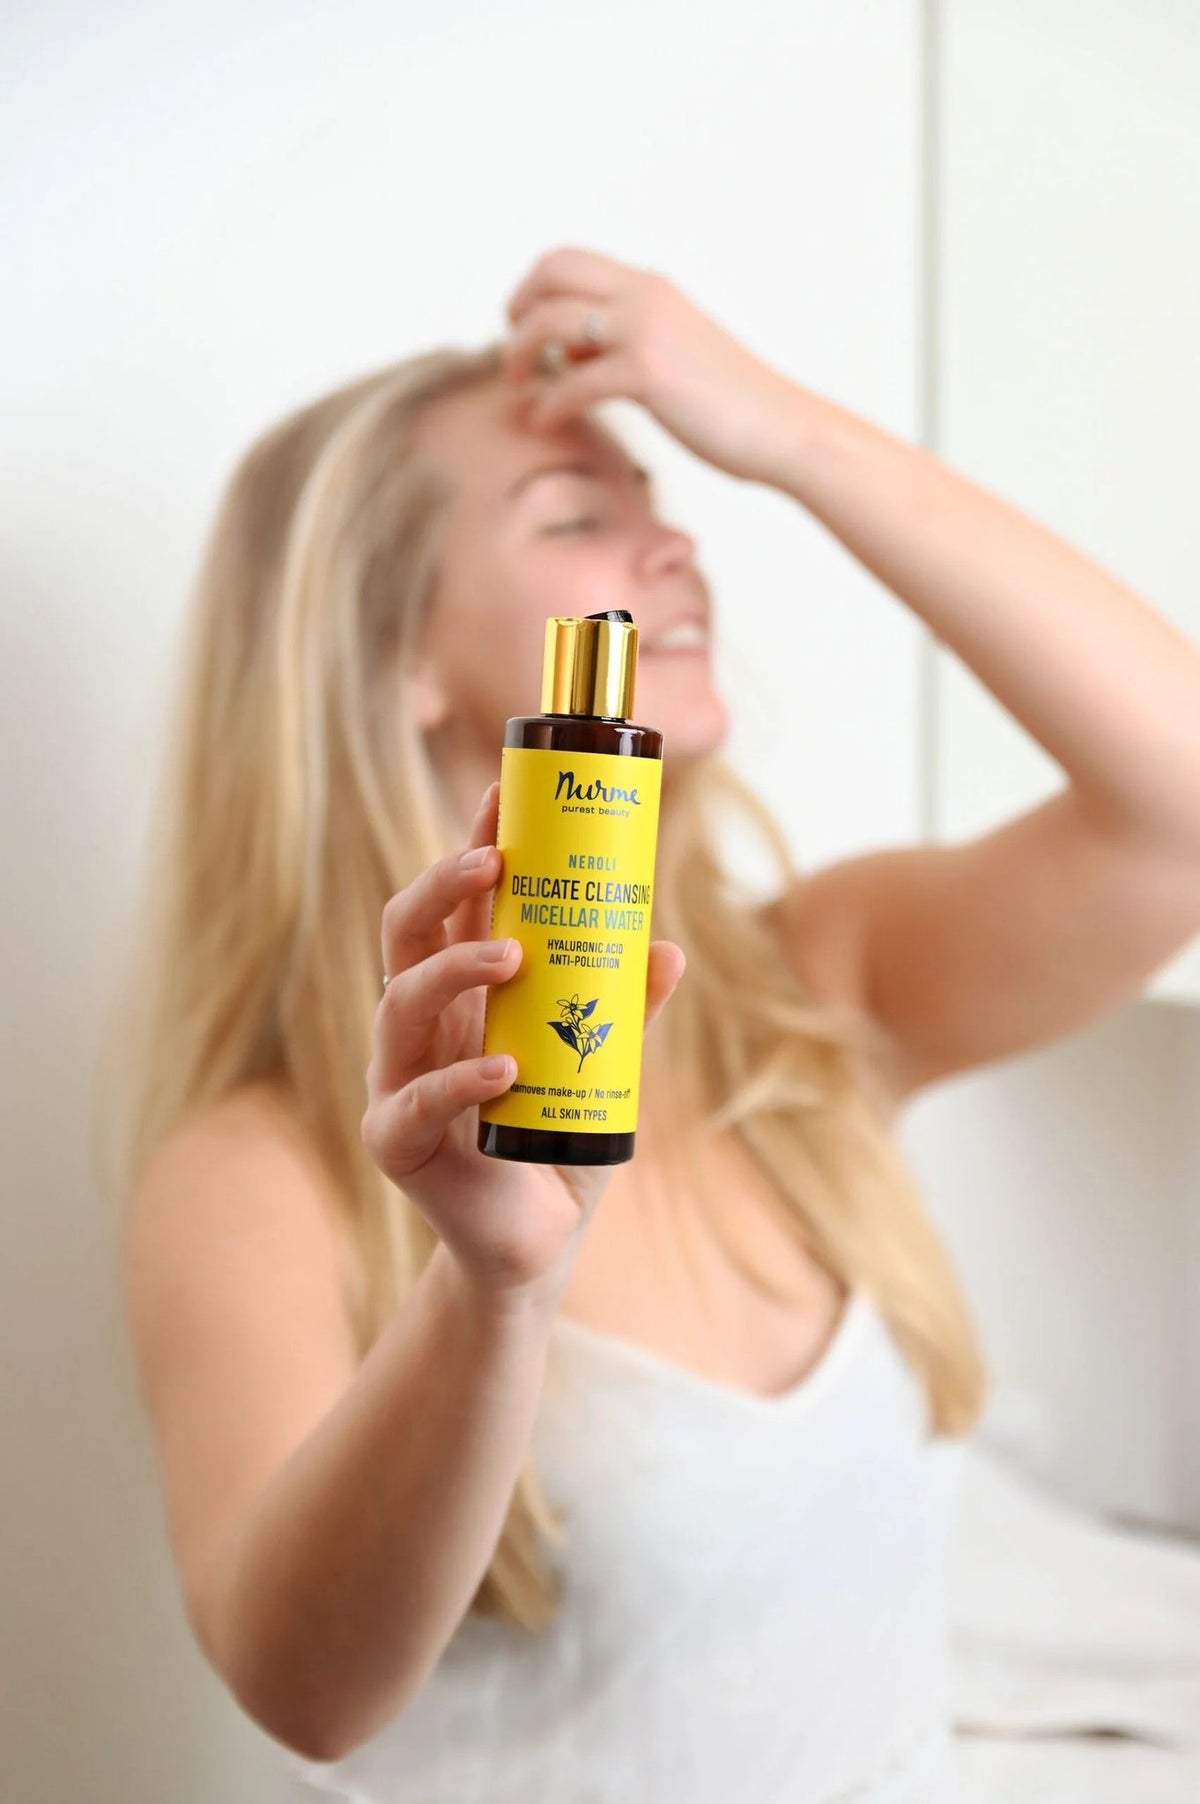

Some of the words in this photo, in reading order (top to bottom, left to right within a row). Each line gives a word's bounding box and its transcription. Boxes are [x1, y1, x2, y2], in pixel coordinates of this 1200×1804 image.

[555, 770, 641, 805] Nurme
[561, 805, 595, 814] purest
[598, 807, 630, 818] beauty
[568, 854, 617, 871] NEROLI
[512, 875, 580, 900] DELICATE
[520, 903, 599, 928] MICELLAR
[604, 909, 644, 931] WATER
[547, 939, 603, 953] HYALURONIC
[605, 942, 624, 955] ACID
[548, 954, 620, 968] ANTI-POLLUTION
[548, 1086, 586, 1099] make-up
[588, 1088, 593, 1099] /
[595, 1089, 604, 1098] No
[541, 1107, 557, 1118] ALL
[560, 1108, 580, 1120] SKIN
[583, 1110, 607, 1121] TYPES
